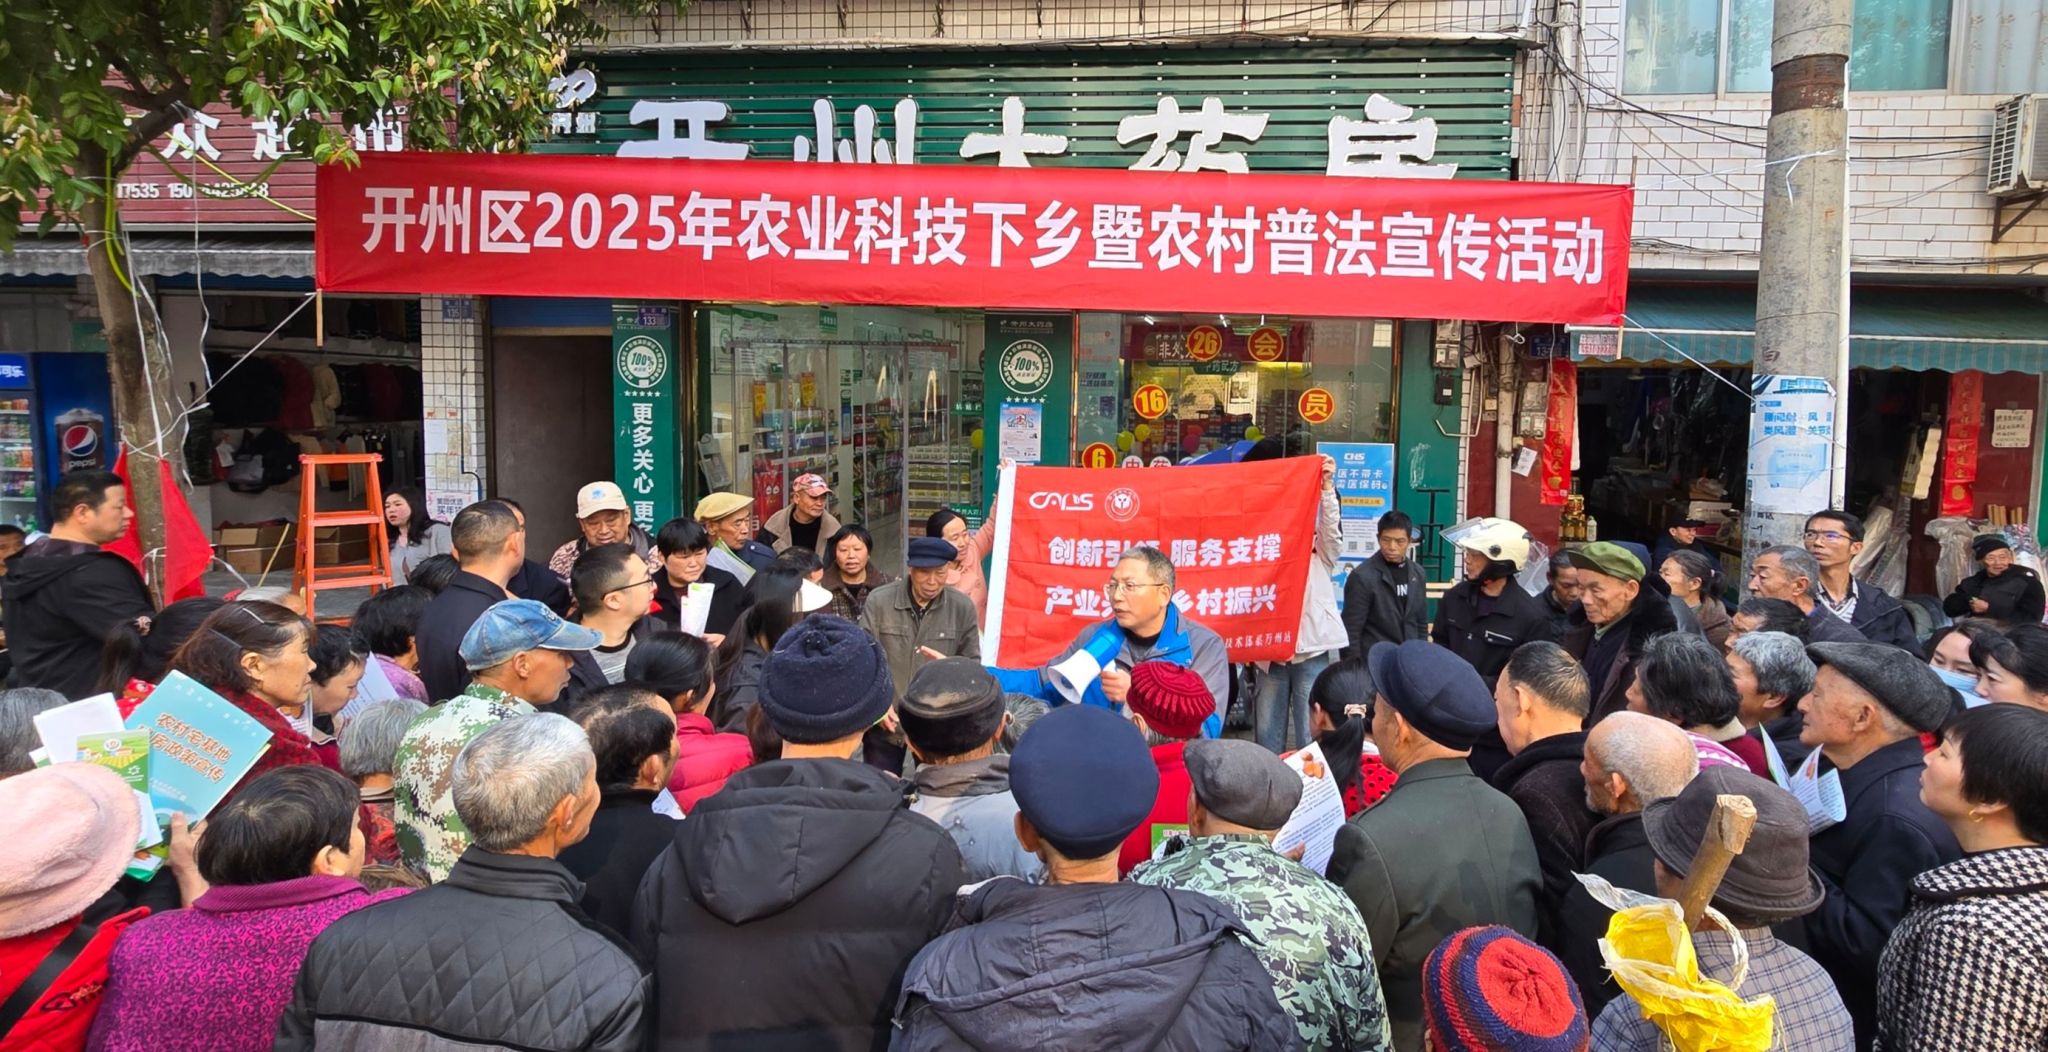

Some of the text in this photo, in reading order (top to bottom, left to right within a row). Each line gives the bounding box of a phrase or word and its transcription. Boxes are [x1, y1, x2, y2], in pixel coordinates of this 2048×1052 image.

[362, 185, 1604, 286] 开州区2025年农业科技下乡暨农村普法宣传活动
[1193, 332, 1217, 354] 26
[1254, 332, 1278, 356] 会
[1014, 357, 1040, 371] 100%
[1138, 389, 1164, 413] 16
[1305, 396, 1329, 418] 员
[632, 402, 655, 494] 更多关心
[1092, 448, 1106, 468] 6
[68, 459, 96, 469] pepsi
[1332, 469, 1383, 479] 医不带卡
[1171, 534, 1281, 567] 服务支撑
[1044, 584, 1277, 618] 产业 乡村振兴
[139, 723, 226, 784] 房政策宣传
